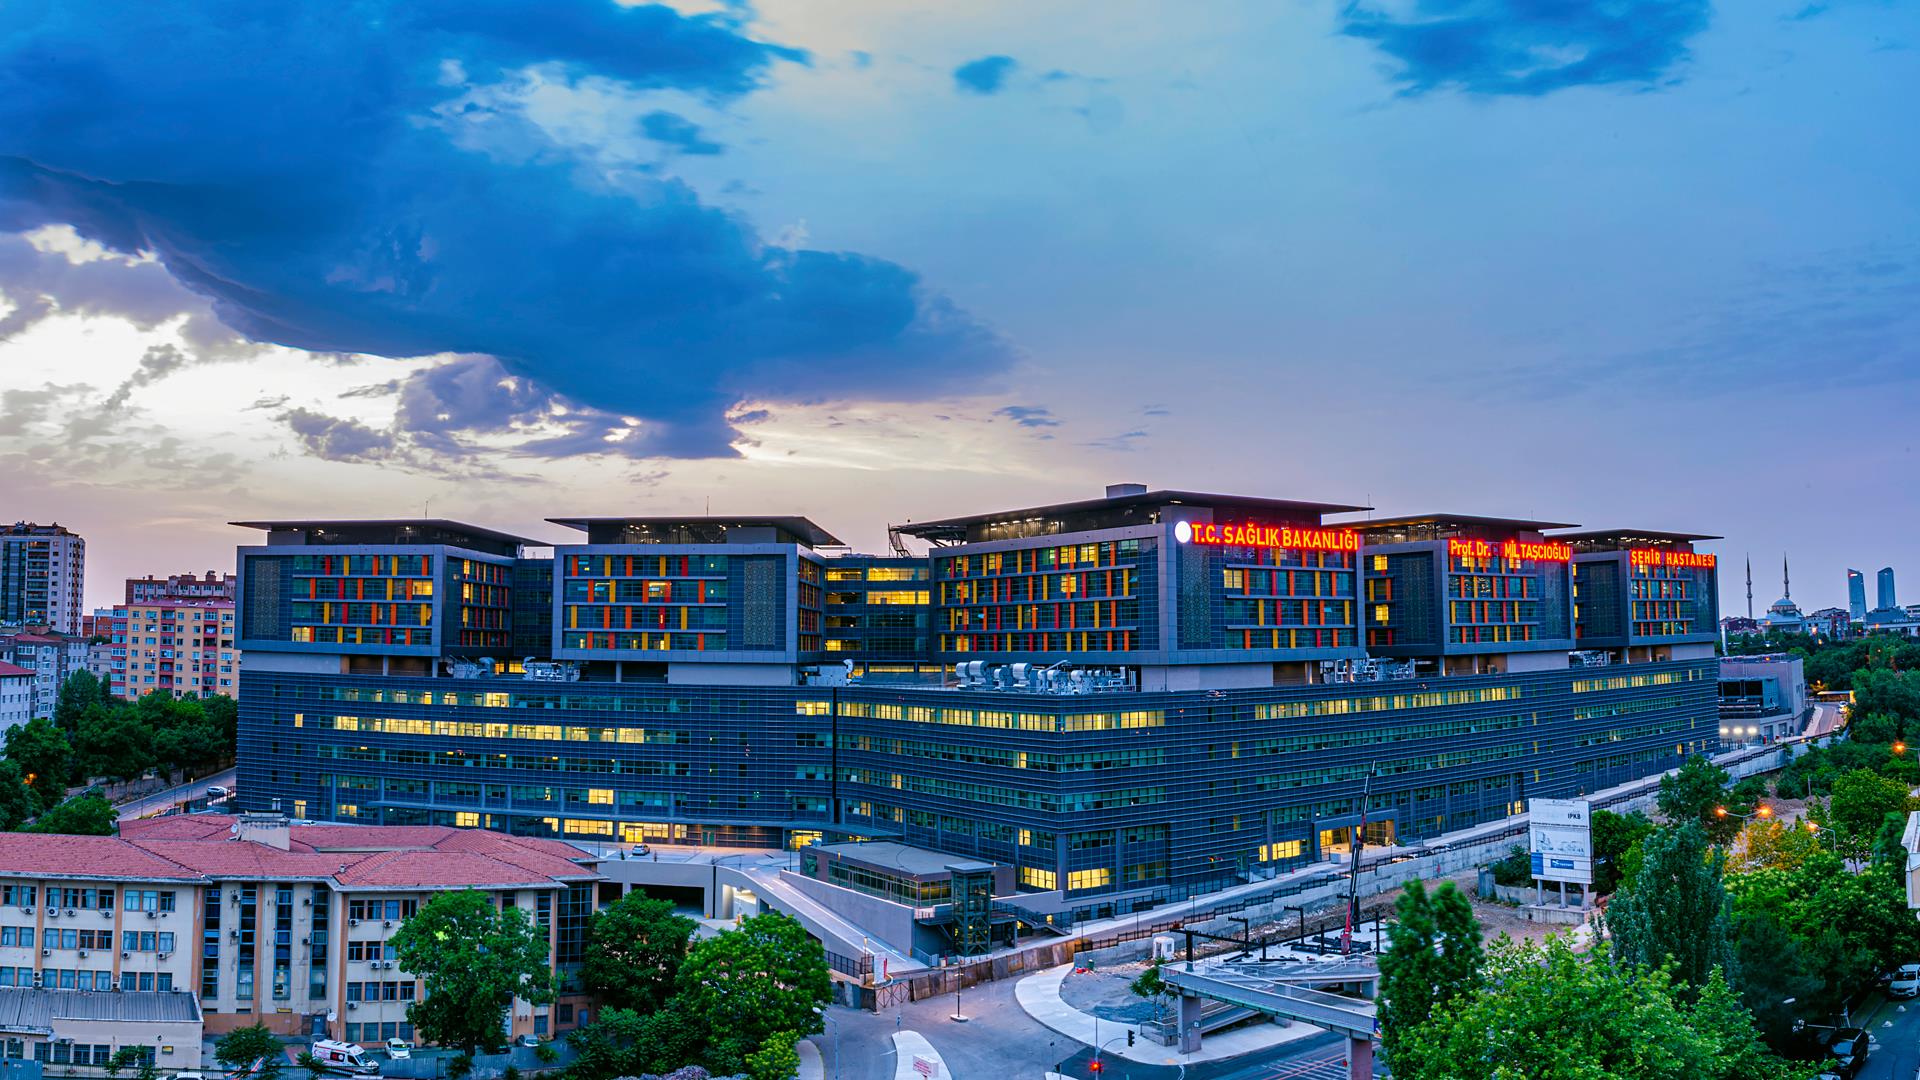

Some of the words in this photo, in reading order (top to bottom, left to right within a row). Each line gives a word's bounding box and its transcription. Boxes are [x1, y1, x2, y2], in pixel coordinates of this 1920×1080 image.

[1192, 523, 1220, 543] T.C.
[1224, 523, 1280, 546] SAĞLIK
[1282, 529, 1358, 550] BAKANLIĞI
[1450, 539, 1475, 555] Prof.
[1476, 541, 1491, 556] Dr.
[1520, 543, 1570, 560] TAŞCIOĞLU
[1631, 549, 1661, 565] ŞEHİR
[1666, 551, 1715, 567] HASTANESİ
